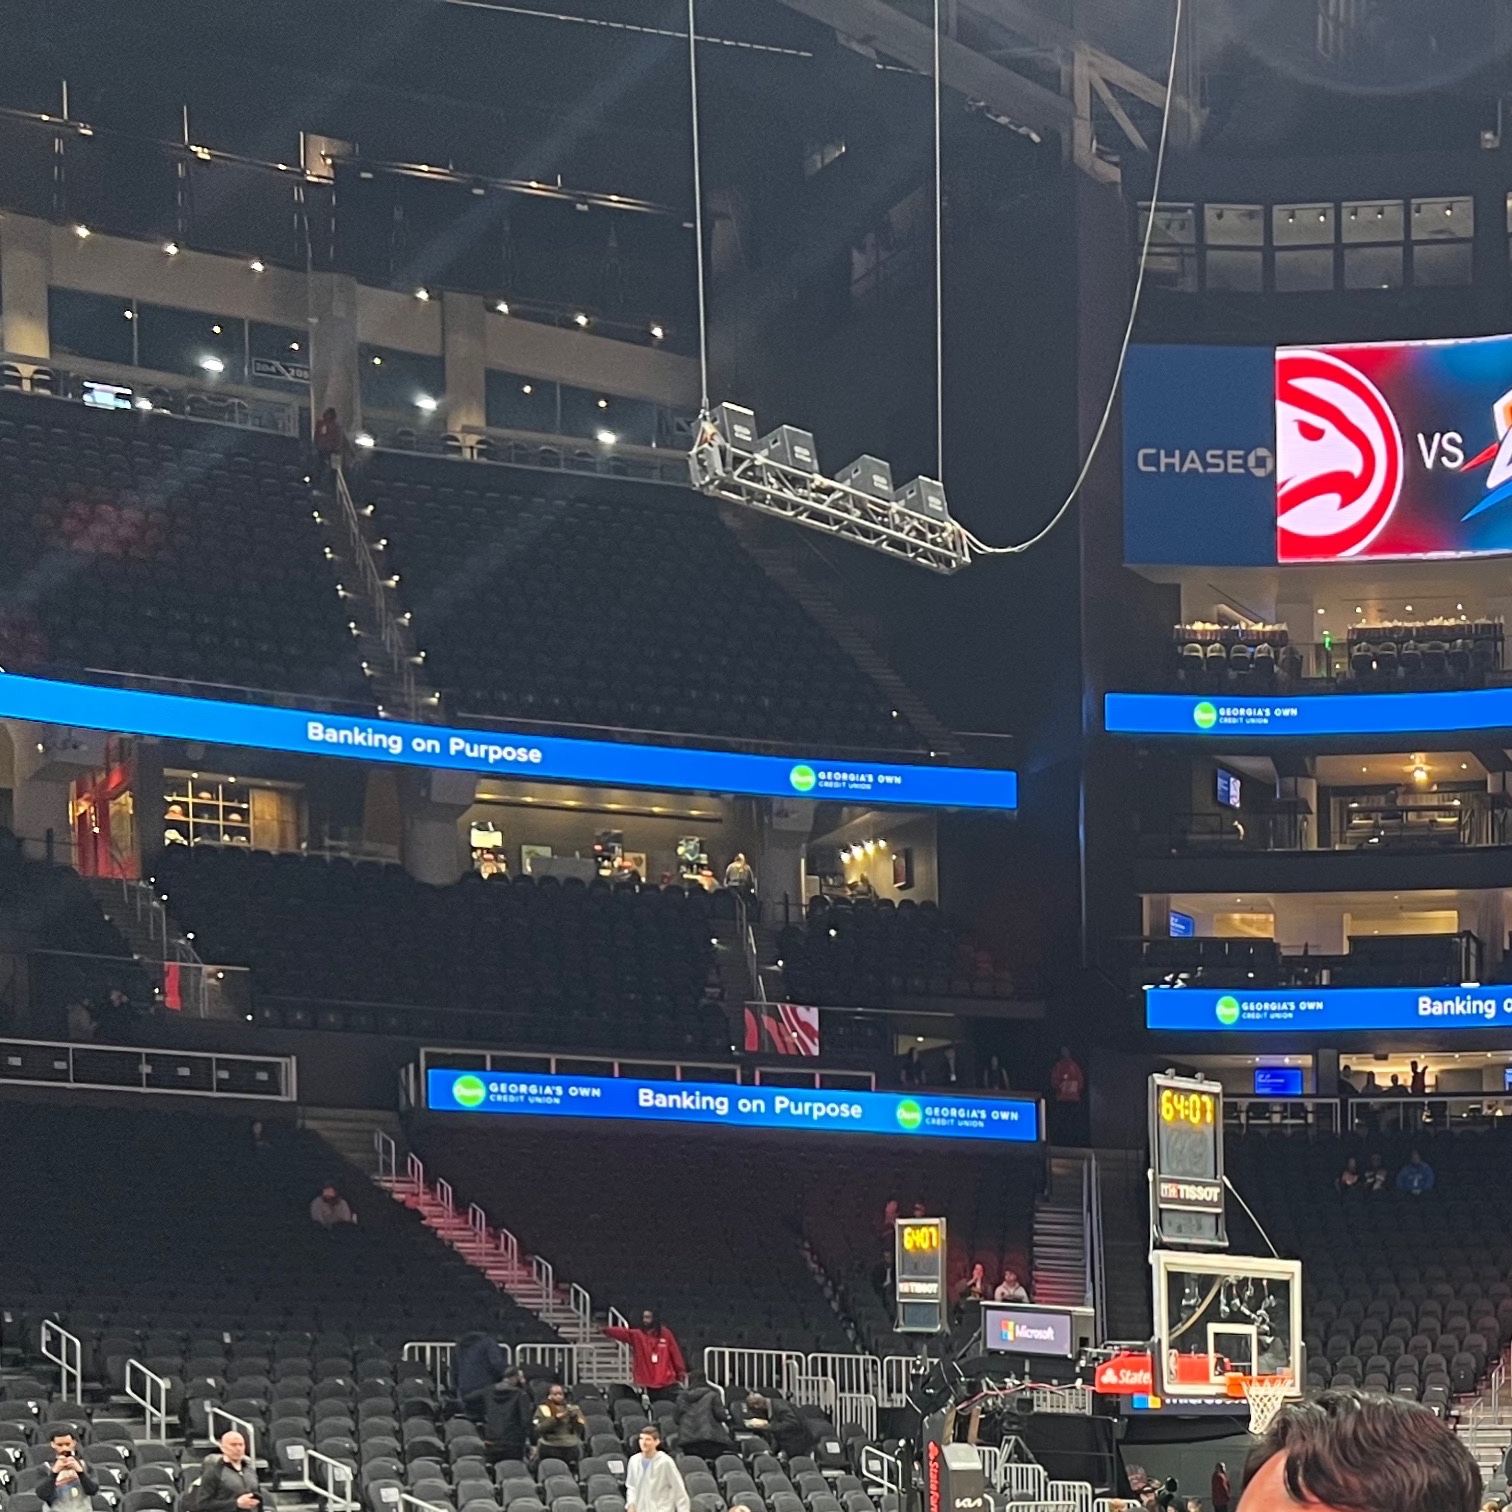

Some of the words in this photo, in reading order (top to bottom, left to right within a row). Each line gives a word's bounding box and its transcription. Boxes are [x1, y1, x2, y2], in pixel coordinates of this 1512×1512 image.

[1417, 431, 1464, 470] VS
[1137, 448, 1246, 473] CHASE
[1219, 707, 1271, 717] GEORGIA'S
[1274, 707, 1298, 717] OWN
[307, 721, 403, 755] Banking
[411, 736, 440, 753] on
[449, 737, 543, 764] Purpose
[818, 771, 874, 783] GEORGIA'S
[877, 774, 902, 784] OWN
[1242, 1001, 1295, 1012] GEORGIA'S
[1299, 1001, 1324, 1011] OWN
[1418, 993, 1496, 1018] Banking
[489, 1082, 563, 1096] GEORGIA'S
[568, 1085, 601, 1098] OWN
[489, 1094, 525, 1103] CREDIT
[528, 1096, 561, 1104] UNION
[638, 1088, 729, 1115] Banking
[738, 1097, 765, 1113] on
[775, 1096, 863, 1120] Purpose
[1160, 1089, 1212, 1124] 64:07
[925, 1106, 987, 1119] GEORGIA'S
[992, 1110, 1019, 1121] OWN
[1179, 1182, 1221, 1202] TISSOT
[1015, 1324, 1055, 1341] Microsoft
[1119, 1368, 1151, 1385] State
